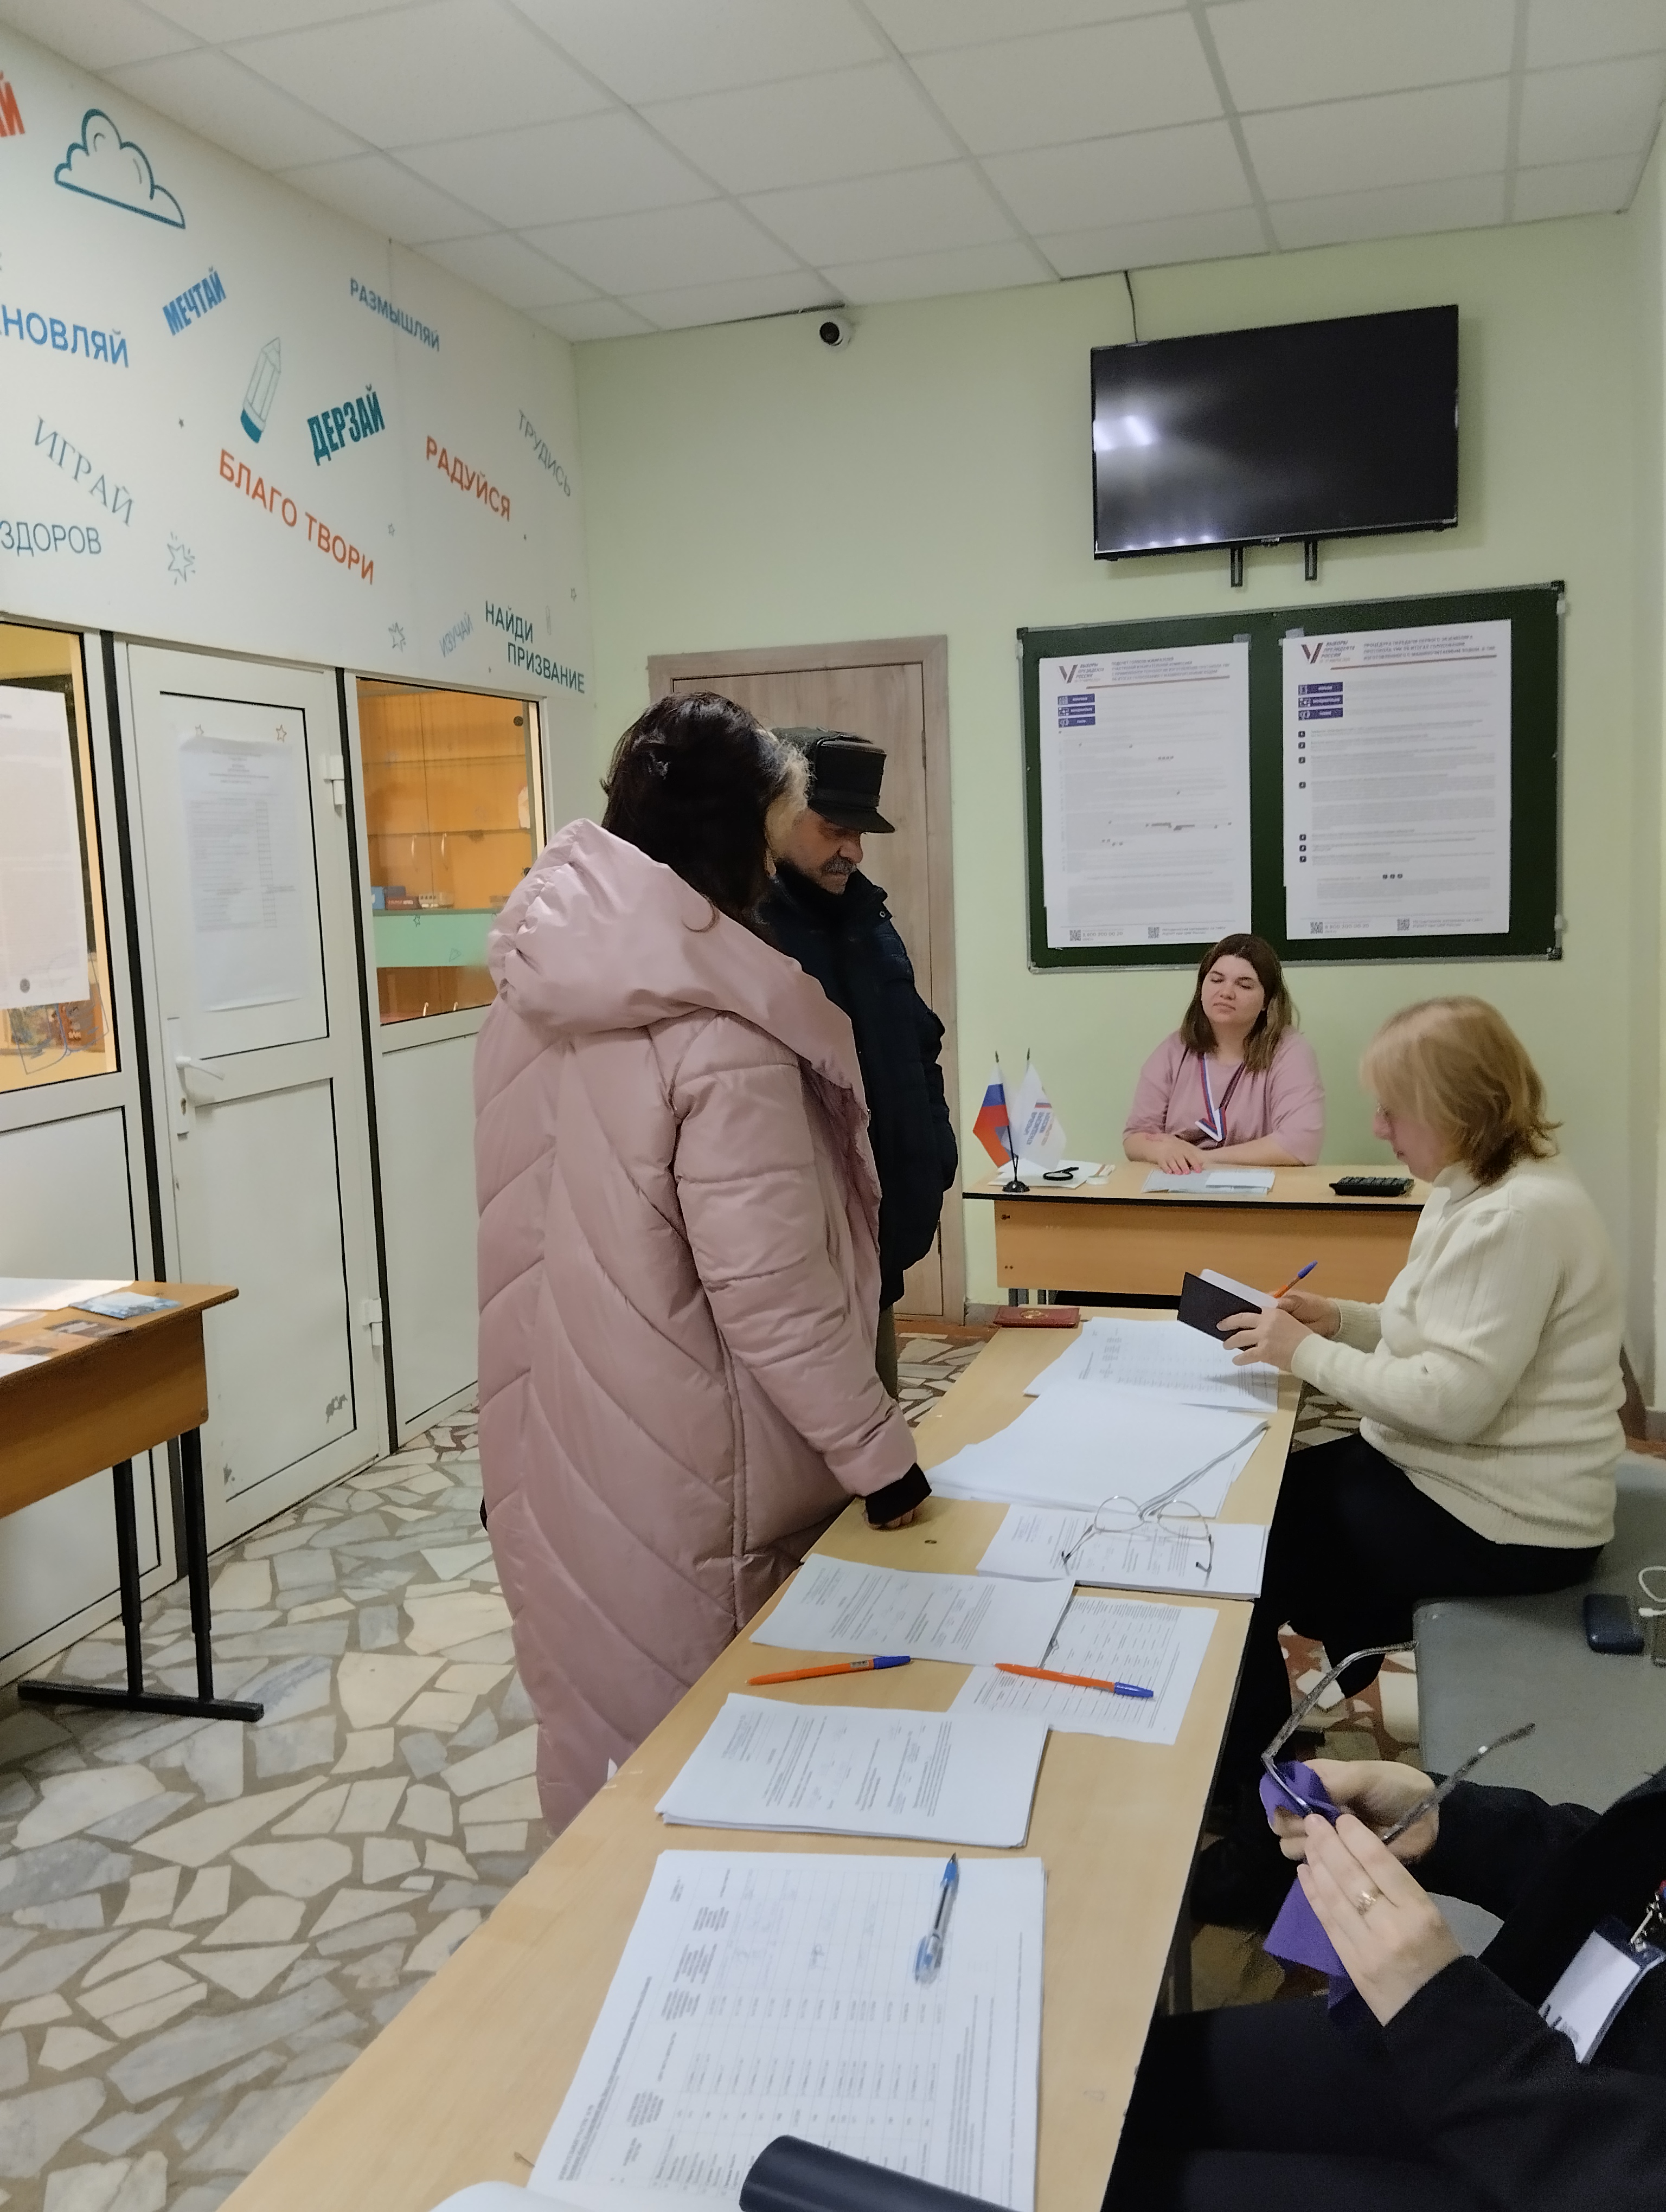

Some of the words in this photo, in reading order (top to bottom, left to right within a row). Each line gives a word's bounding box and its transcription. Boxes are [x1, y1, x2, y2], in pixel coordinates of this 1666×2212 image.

[0, 304, 129, 368] НОВЛЯЙ
[163, 265, 226, 335] МЕЧТАЙ
[350, 277, 440, 352] РАЗМЫШЛЯЙ
[307, 383, 385, 466] ДЕРЗАЙ
[519, 409, 571, 497] ТРУДИСЬ
[34, 415, 134, 527] ИГРАЙ
[426, 435, 510, 522] РАДУЙСЯ
[0, 520, 101, 557] ЗДОРОВ
[220, 448, 297, 527] БЛАГО
[305, 511, 374, 585] ТВОРИ
[439, 612, 473, 658] ИЗУЧАЙ
[486, 600, 533, 644] НАЙДИ
[508, 642, 585, 694] ПРИЗВАНИЕ
